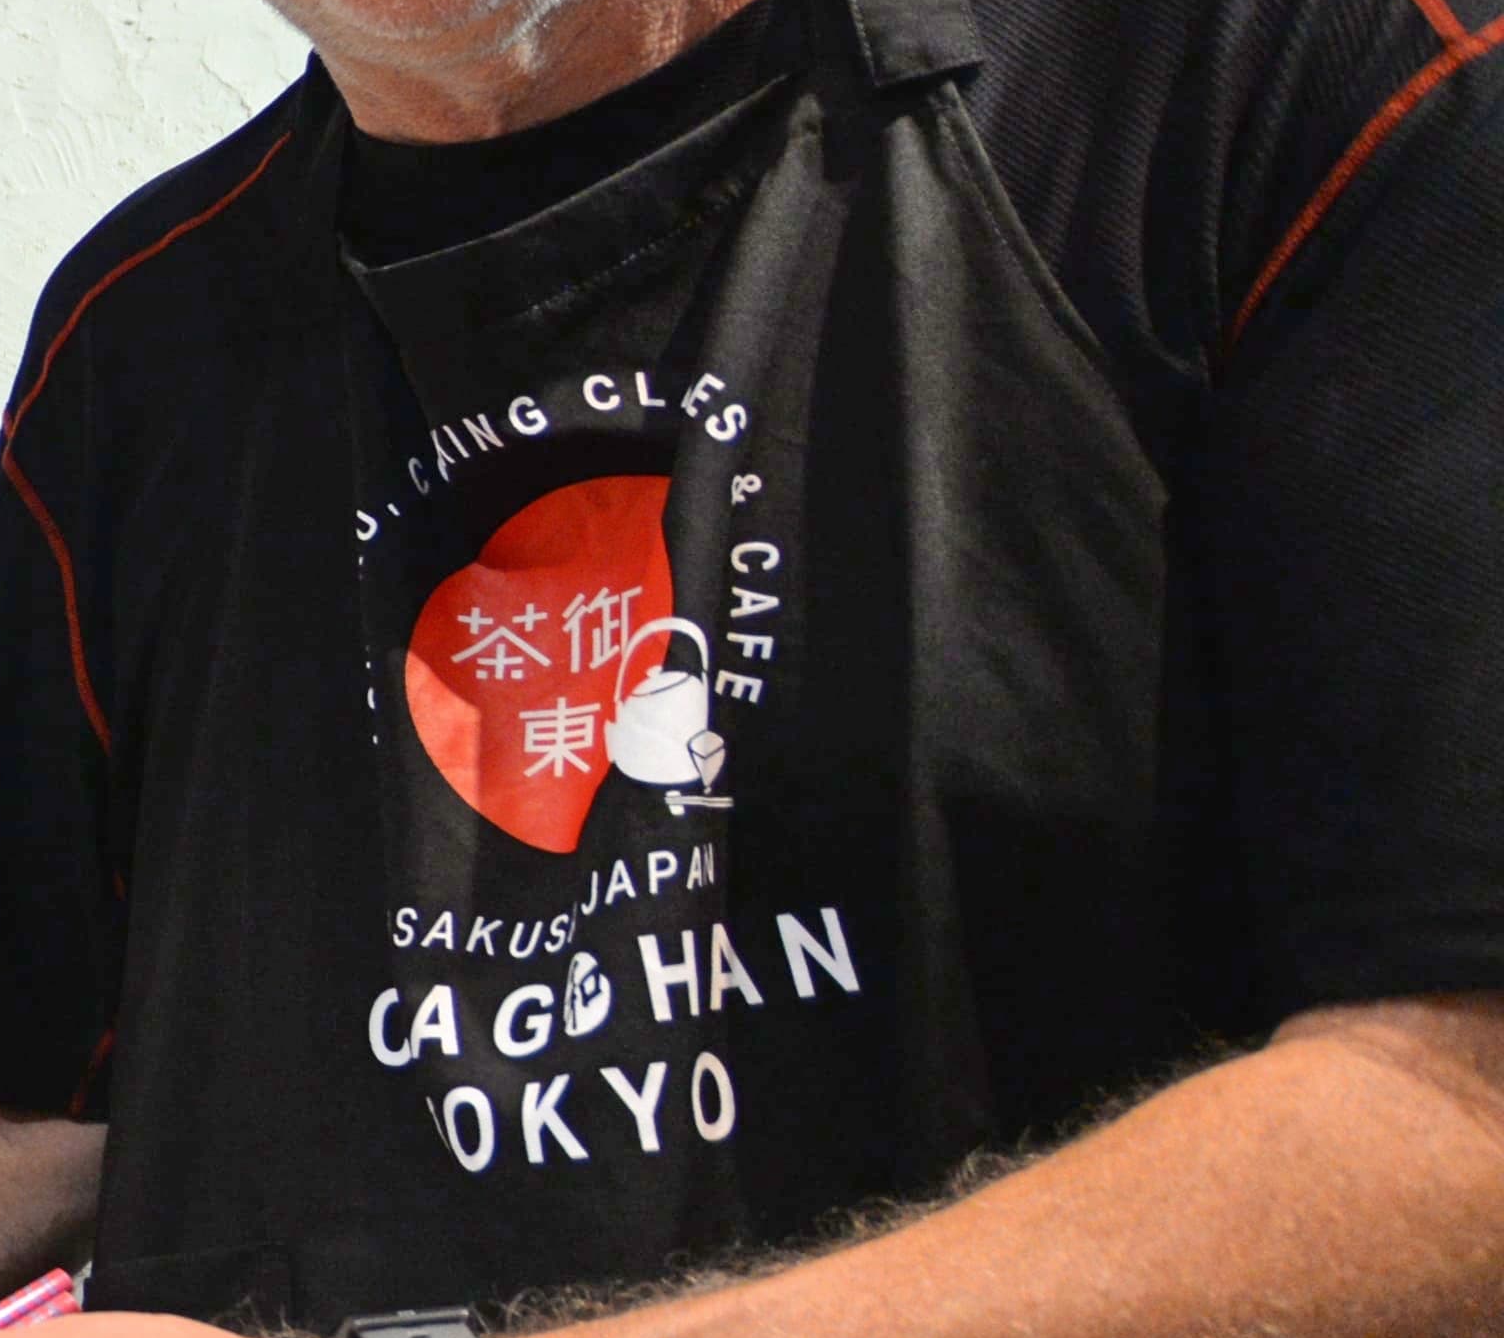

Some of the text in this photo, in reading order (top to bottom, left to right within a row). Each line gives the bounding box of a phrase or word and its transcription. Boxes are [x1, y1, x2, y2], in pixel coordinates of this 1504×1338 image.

[730, 473, 763, 506] &
[715, 539, 781, 705] CAFE
[581, 842, 716, 916] JAPAN
[428, 1051, 737, 1173] OKYO
